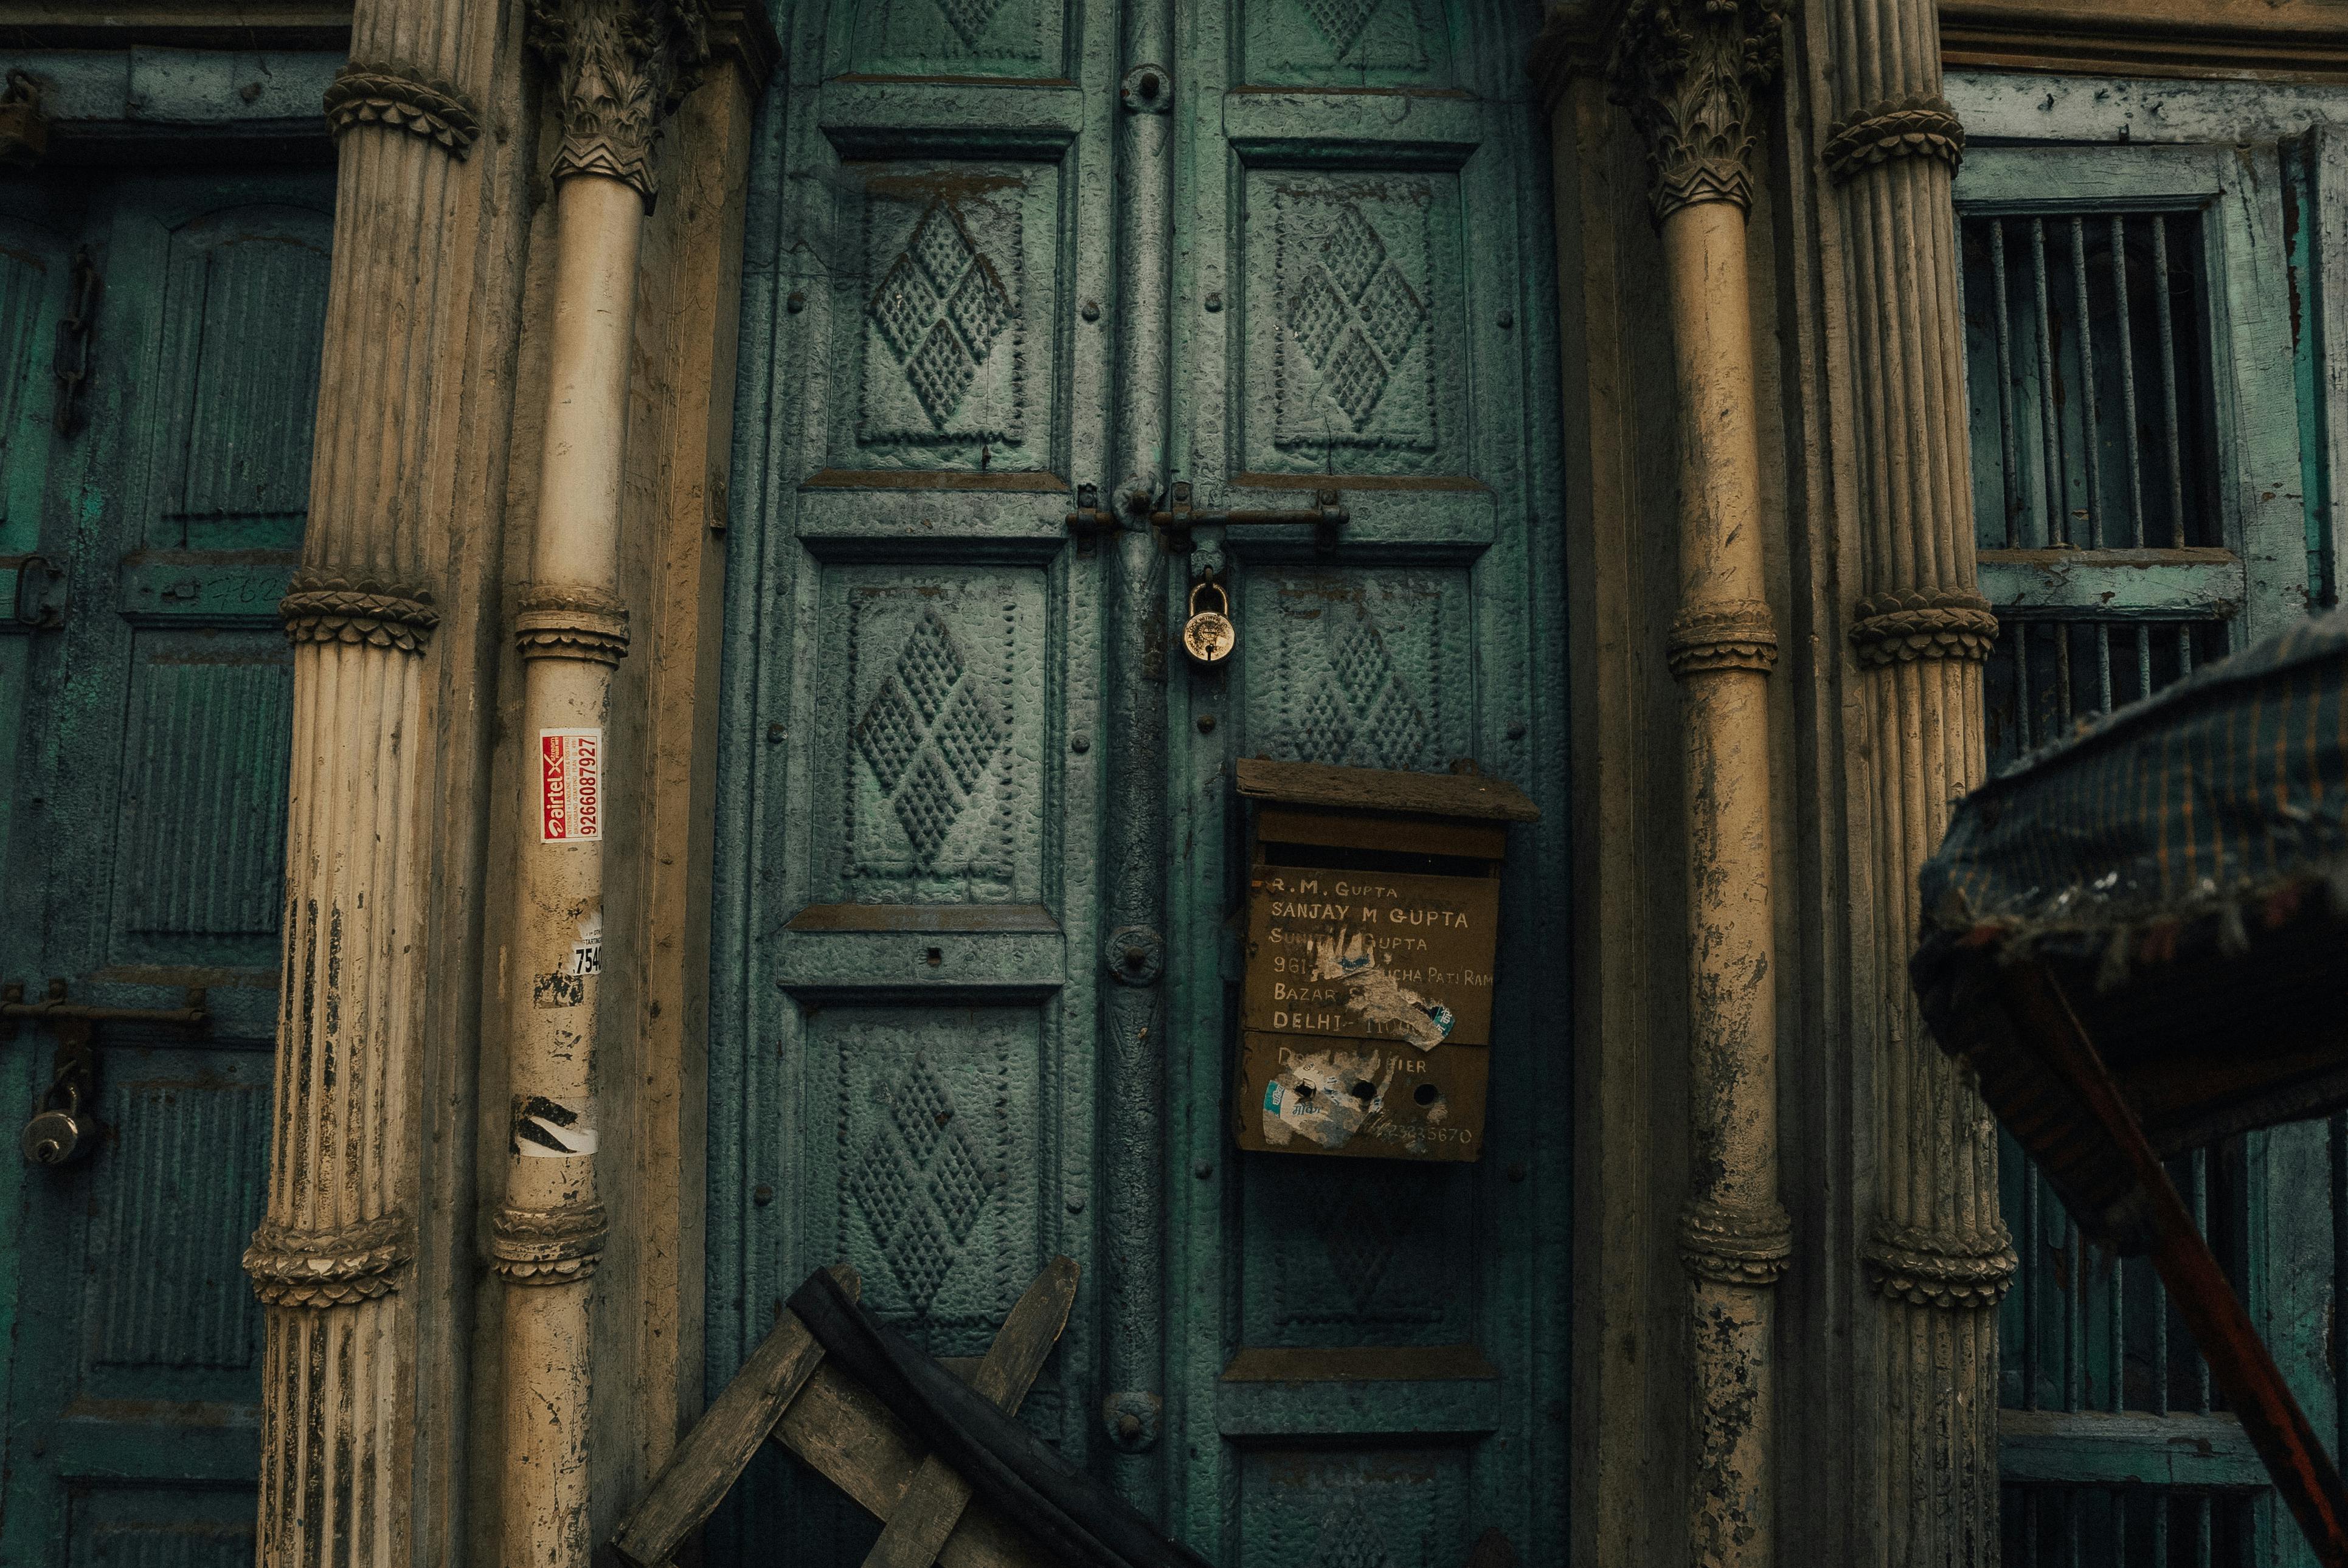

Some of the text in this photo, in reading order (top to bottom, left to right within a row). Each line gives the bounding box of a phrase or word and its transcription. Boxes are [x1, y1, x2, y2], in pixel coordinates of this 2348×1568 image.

[547, 776, 564, 819] airtel
[578, 738, 596, 835] 9266087927
[1335, 882, 1397, 899] GUPTA
[1272, 901, 1468, 928] SANJAY M GUPTA
[573, 946, 602, 974] 7540
[1274, 983, 1336, 1002] BAZAR
